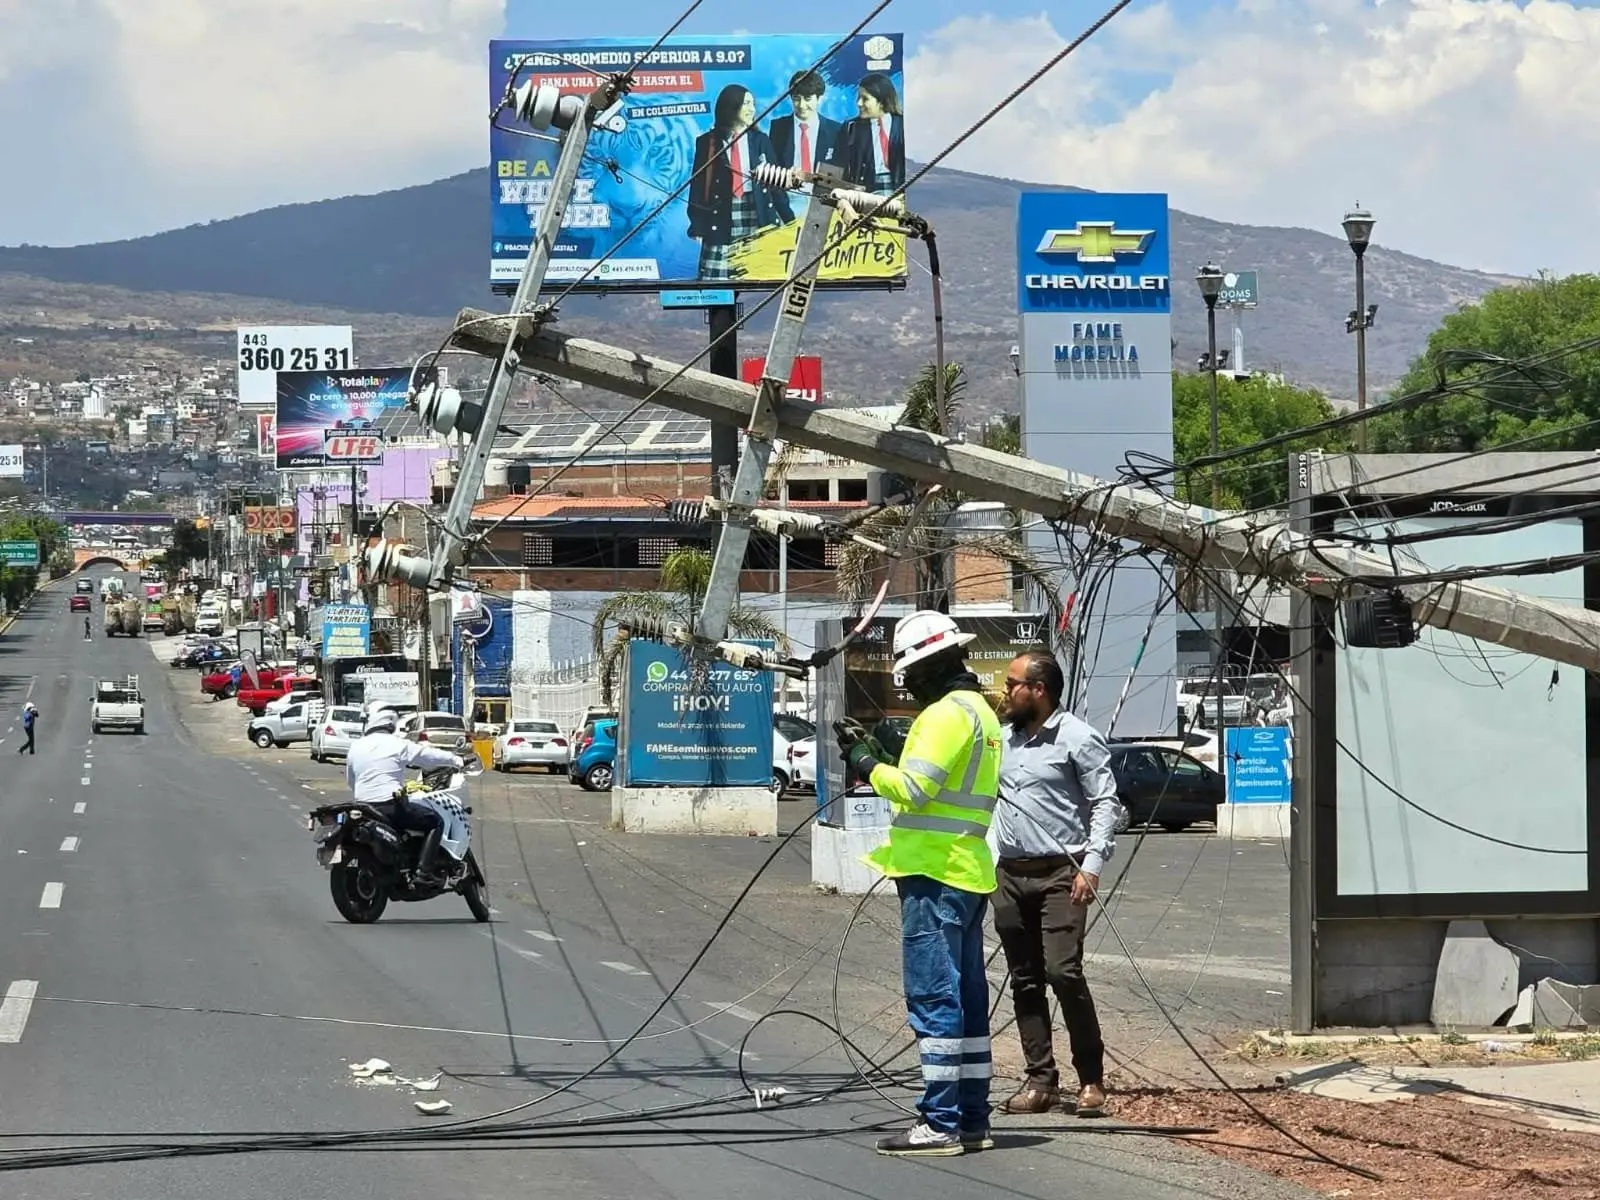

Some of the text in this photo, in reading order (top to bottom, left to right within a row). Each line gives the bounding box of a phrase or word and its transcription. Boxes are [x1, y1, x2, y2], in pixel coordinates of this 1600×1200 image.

[504, 50, 746, 69] ¿TIENES PROMEDIO SUPERIOR A 9.0?
[571, 76, 594, 88] UNA
[643, 75, 678, 87] HASTA
[680, 74, 694, 86] EL
[632, 103, 707, 118] EN COLEGIATURA
[498, 160, 552, 177] BE A
[823, 241, 897, 270] LIMITES
[1025, 274, 1168, 290] CHEVROLET
[1072, 322, 1123, 339] FAME
[243, 333, 268, 346] 443
[240, 347, 349, 371] 360 25 31
[1054, 344, 1139, 361] MORELIA
[339, 375, 385, 388] Totalplay
[331, 439, 377, 457] LTH
[13, 456, 22, 465] 31
[670, 671, 688, 680] 44
[708, 670, 731, 680] 277
[716, 683, 730, 693] TU
[732, 683, 762, 693] AUTO
[673, 695, 730, 712] ¡HOY!
[646, 744, 758, 754] FAMEseminuevos.com
